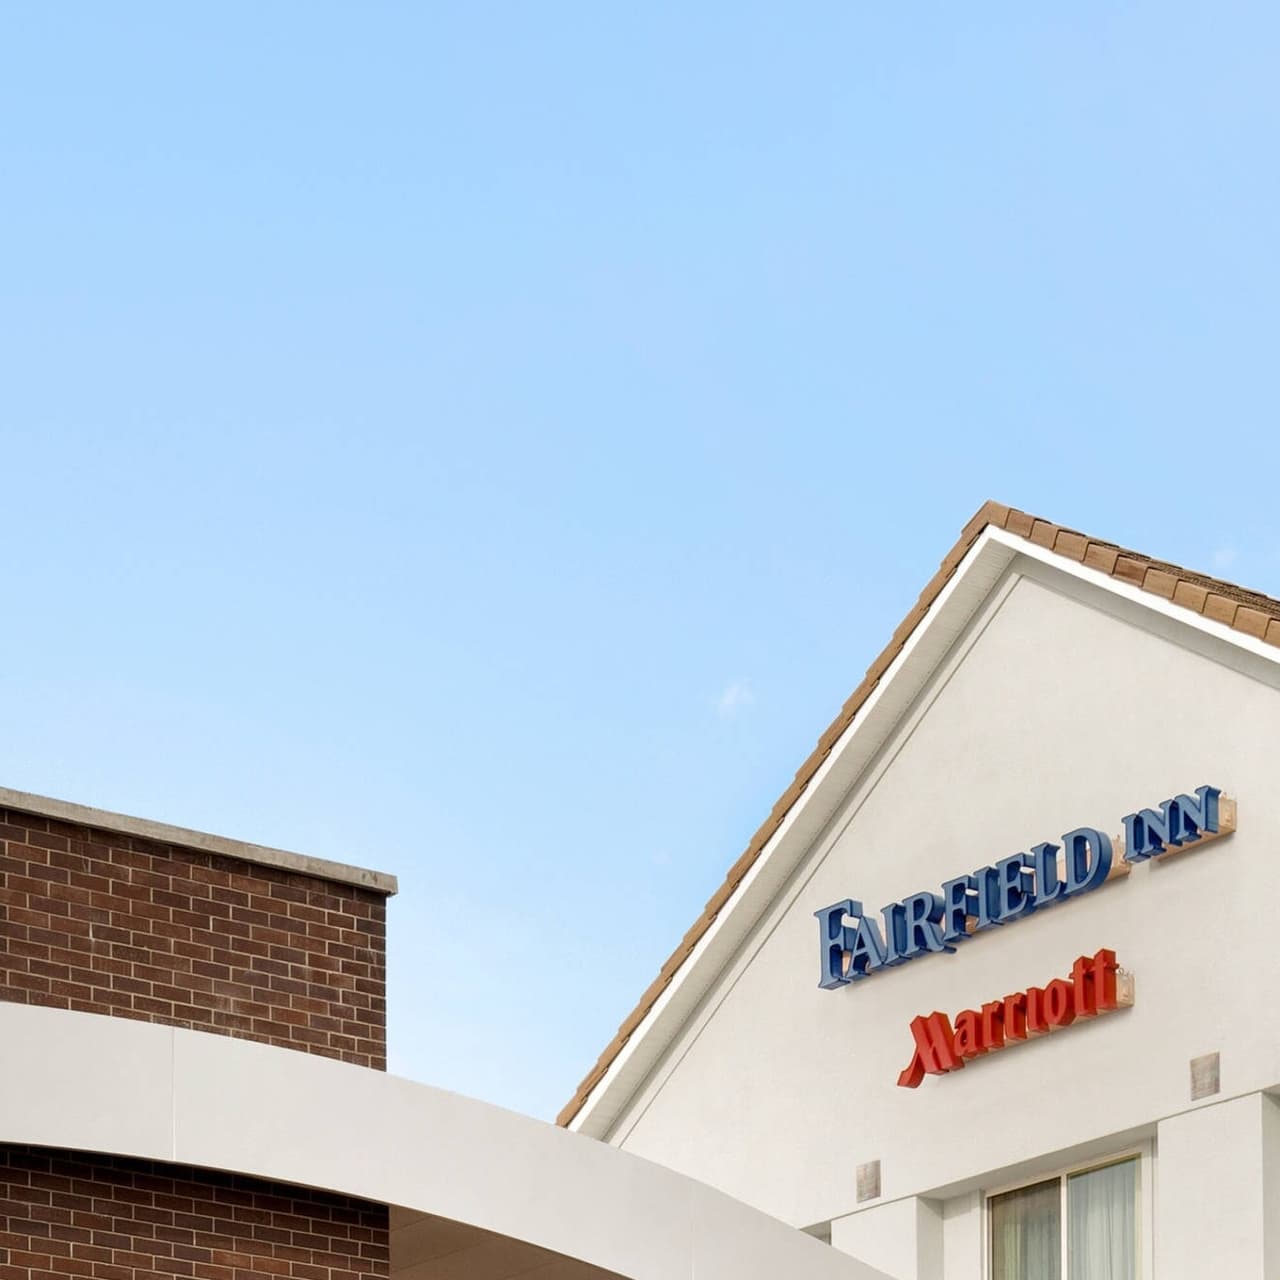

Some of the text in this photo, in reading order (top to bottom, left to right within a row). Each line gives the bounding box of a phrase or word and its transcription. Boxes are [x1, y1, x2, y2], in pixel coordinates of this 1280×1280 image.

[813, 785, 1222, 990] FAIRFIELD INN
[897, 949, 1120, 1089] Marriott
